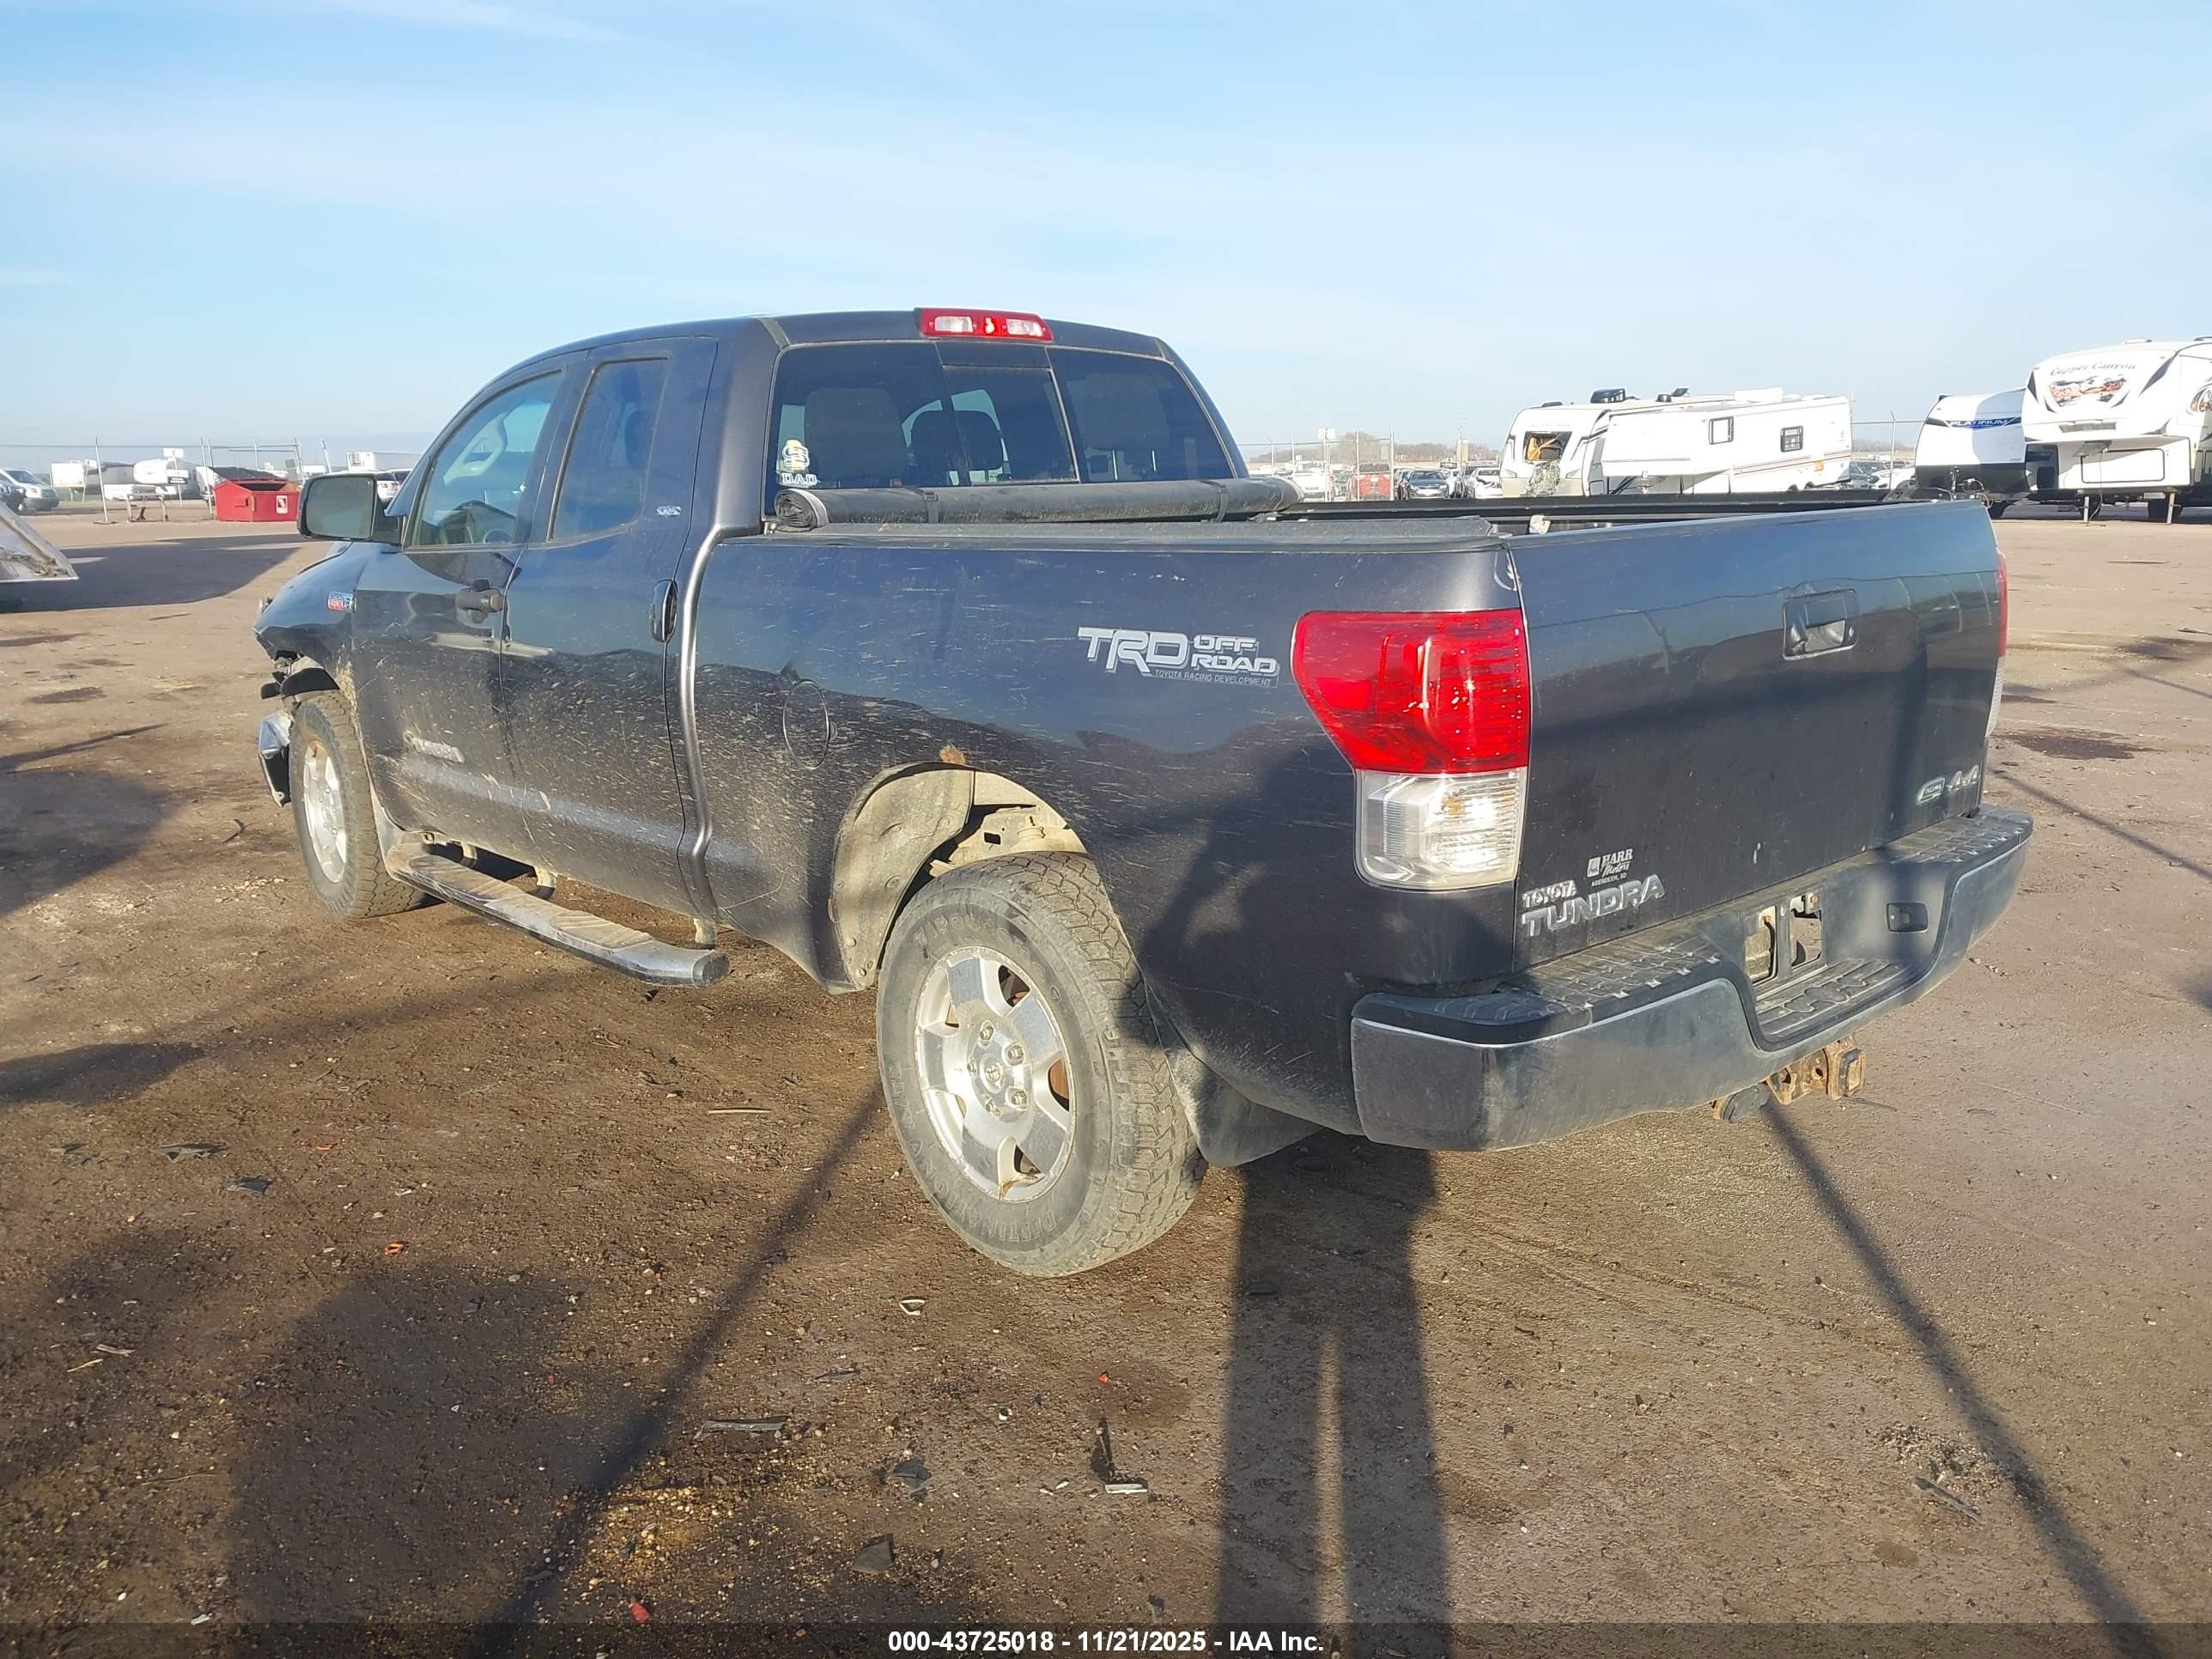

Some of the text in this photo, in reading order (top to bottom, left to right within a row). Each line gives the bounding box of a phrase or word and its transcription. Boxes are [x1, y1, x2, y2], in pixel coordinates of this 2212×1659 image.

[780, 471, 817, 486] DAD
[1078, 627, 1189, 673] TRD
[1194, 635, 1256, 652] OFF
[1191, 654, 1278, 674] ROAD
[1155, 669, 1272, 687] TOYOTA RACING DEVELOPMENT
[1522, 879, 1577, 908] TOYOTA
[1521, 873, 1665, 937] TUNDRA
